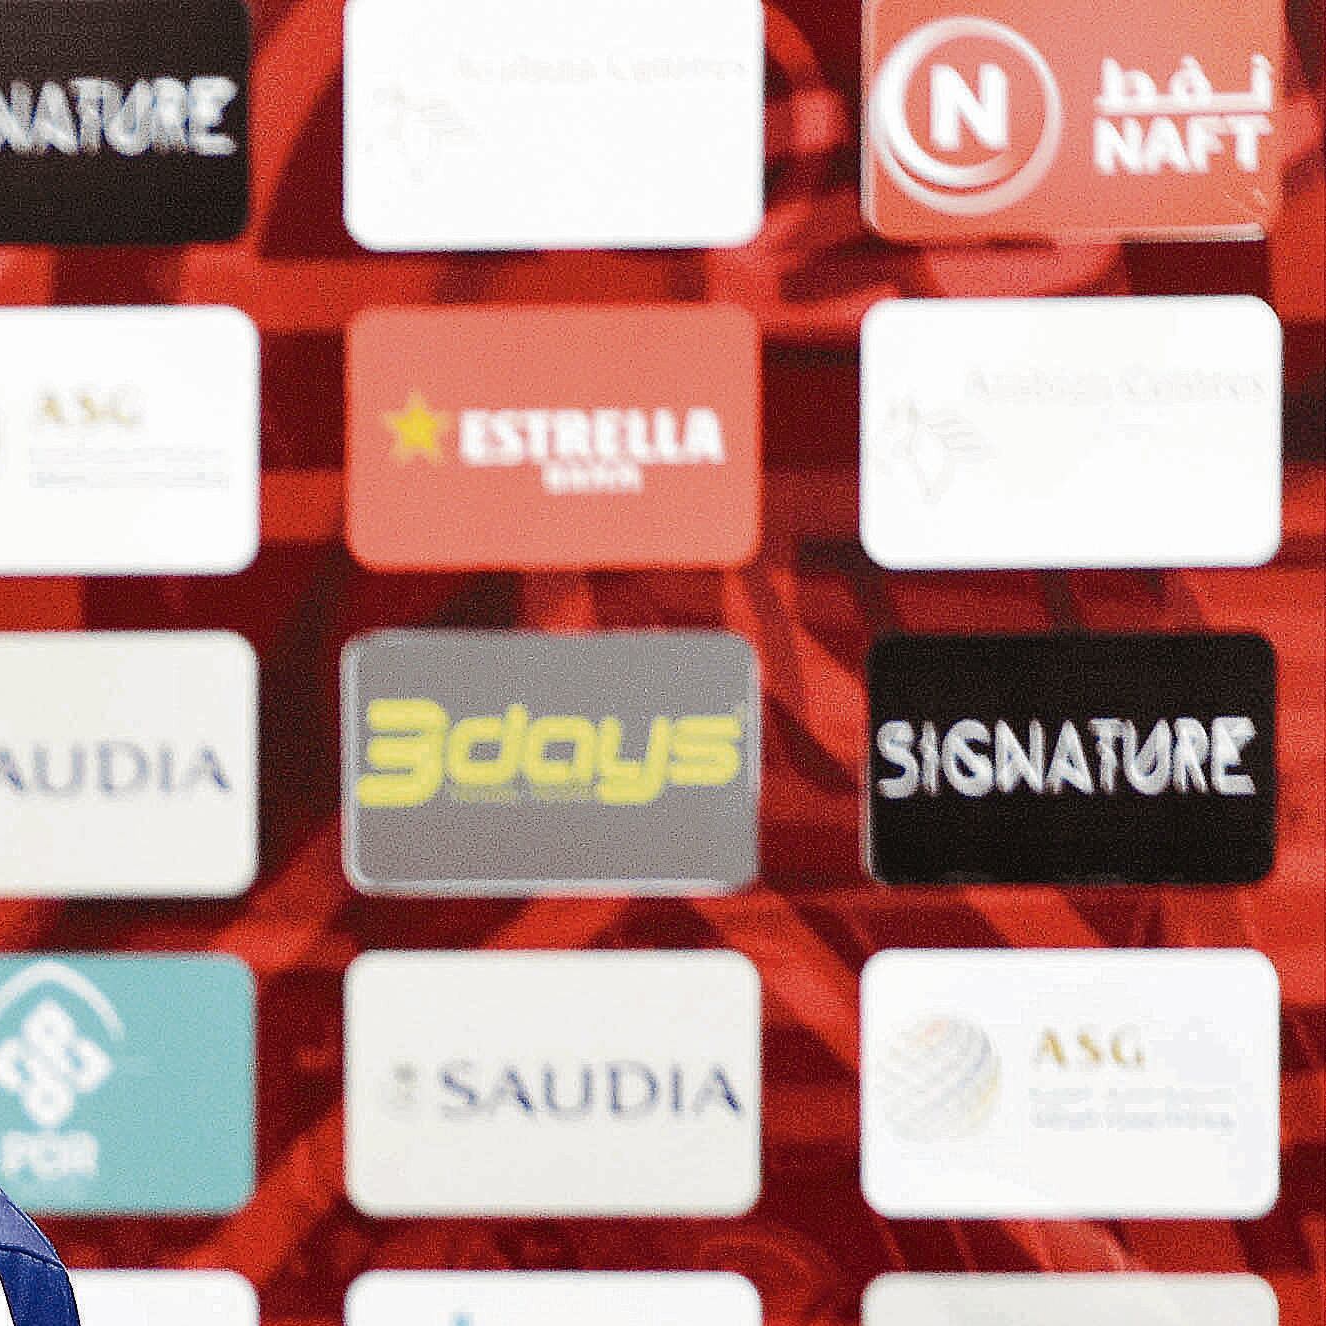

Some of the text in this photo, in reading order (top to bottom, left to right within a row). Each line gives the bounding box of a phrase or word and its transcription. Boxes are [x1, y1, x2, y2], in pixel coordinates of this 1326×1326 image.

[929, 63, 1009, 150] N
[1092, 114, 1273, 175] NAFT
[459, 408, 725, 466] ESTRELLA
[358, 697, 743, 806] 3days
[876, 716, 1257, 799] SIGNATURE
[1034, 1025, 1147, 1068] ASG
[439, 1062, 745, 1120] SAUDIA
